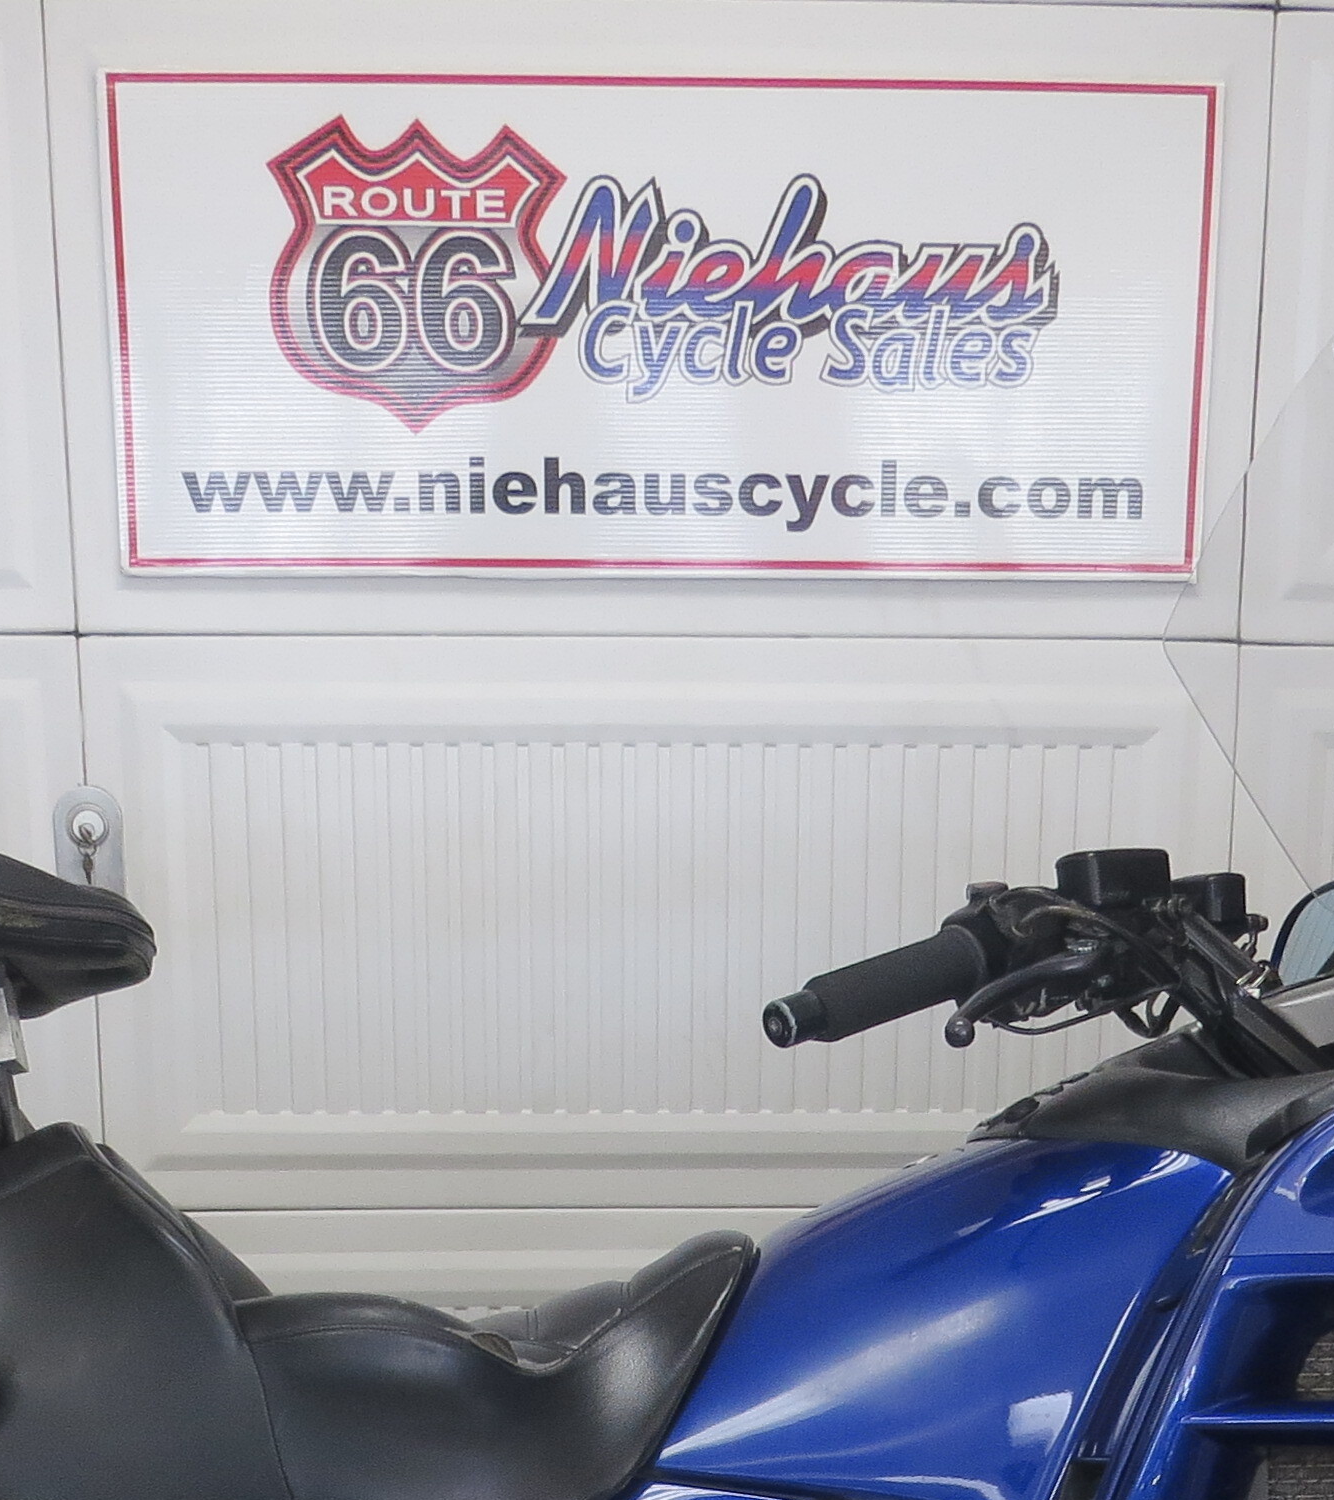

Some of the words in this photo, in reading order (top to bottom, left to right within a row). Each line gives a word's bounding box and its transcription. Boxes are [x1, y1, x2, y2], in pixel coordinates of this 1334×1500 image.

[322, 185, 507, 220] ROUTE
[309, 226, 516, 376] 66
[518, 174, 1059, 337] Niehaus
[578, 300, 804, 404] Cycle
[820, 303, 1038, 392] Sales
[181, 457, 1144, 533] www.niehauscycle.com
